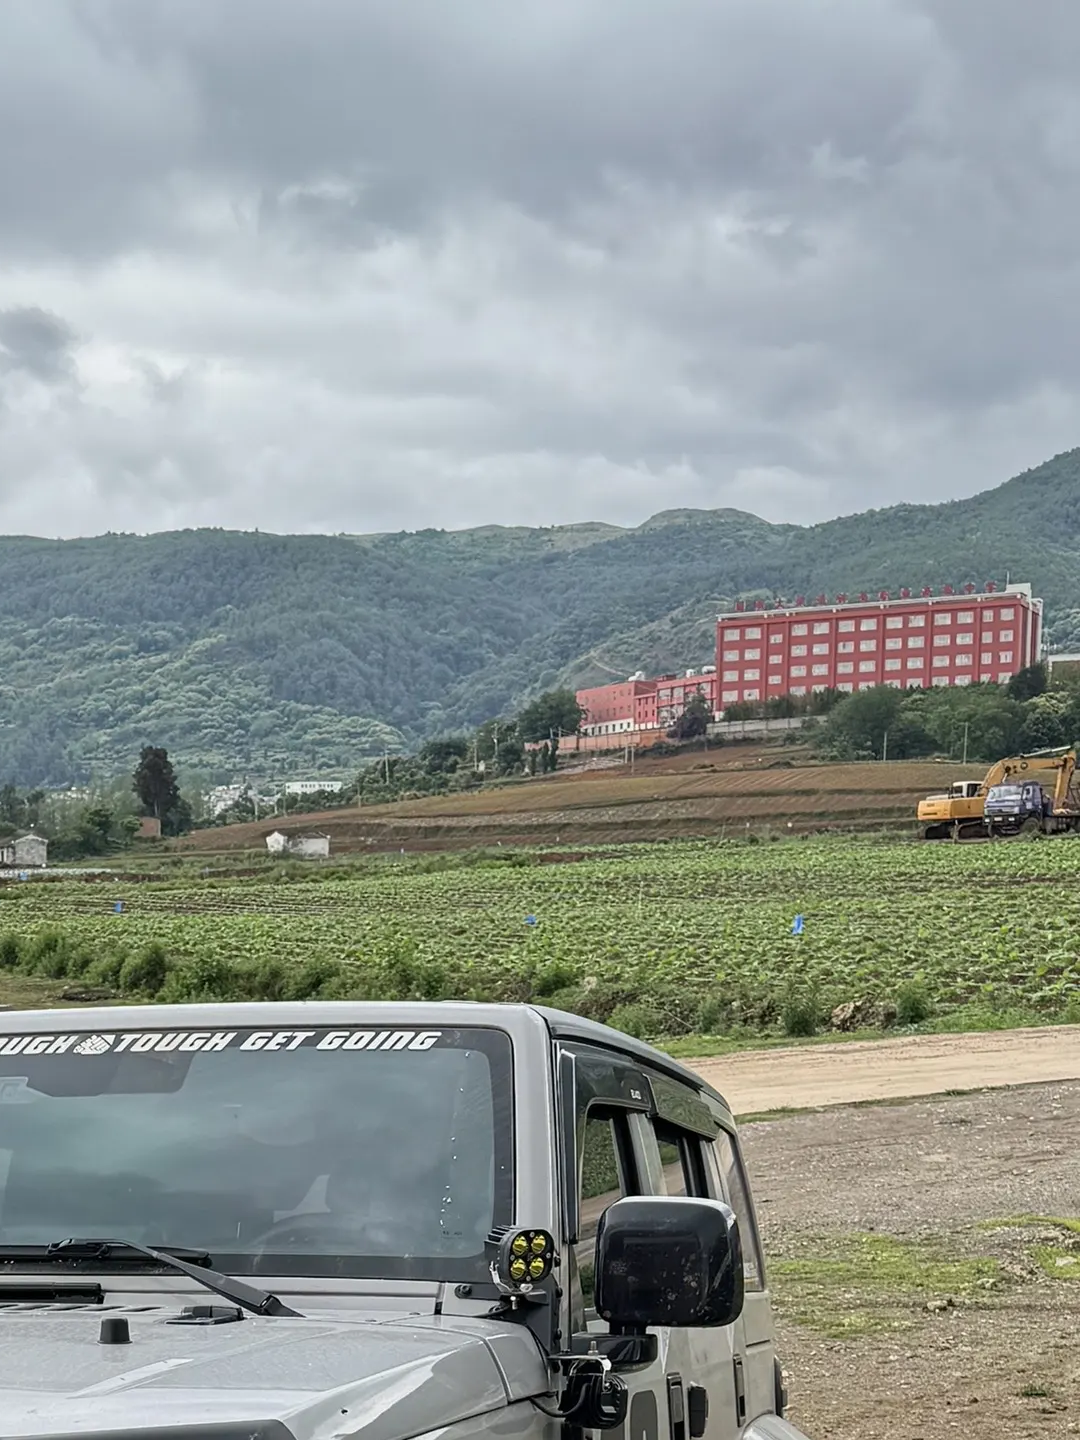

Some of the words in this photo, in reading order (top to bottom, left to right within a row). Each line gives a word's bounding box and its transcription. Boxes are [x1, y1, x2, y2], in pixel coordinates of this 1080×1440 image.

[113, 1031, 239, 1053] TOUGH
[239, 1031, 316, 1051] GET
[316, 1031, 442, 1051] GOING
